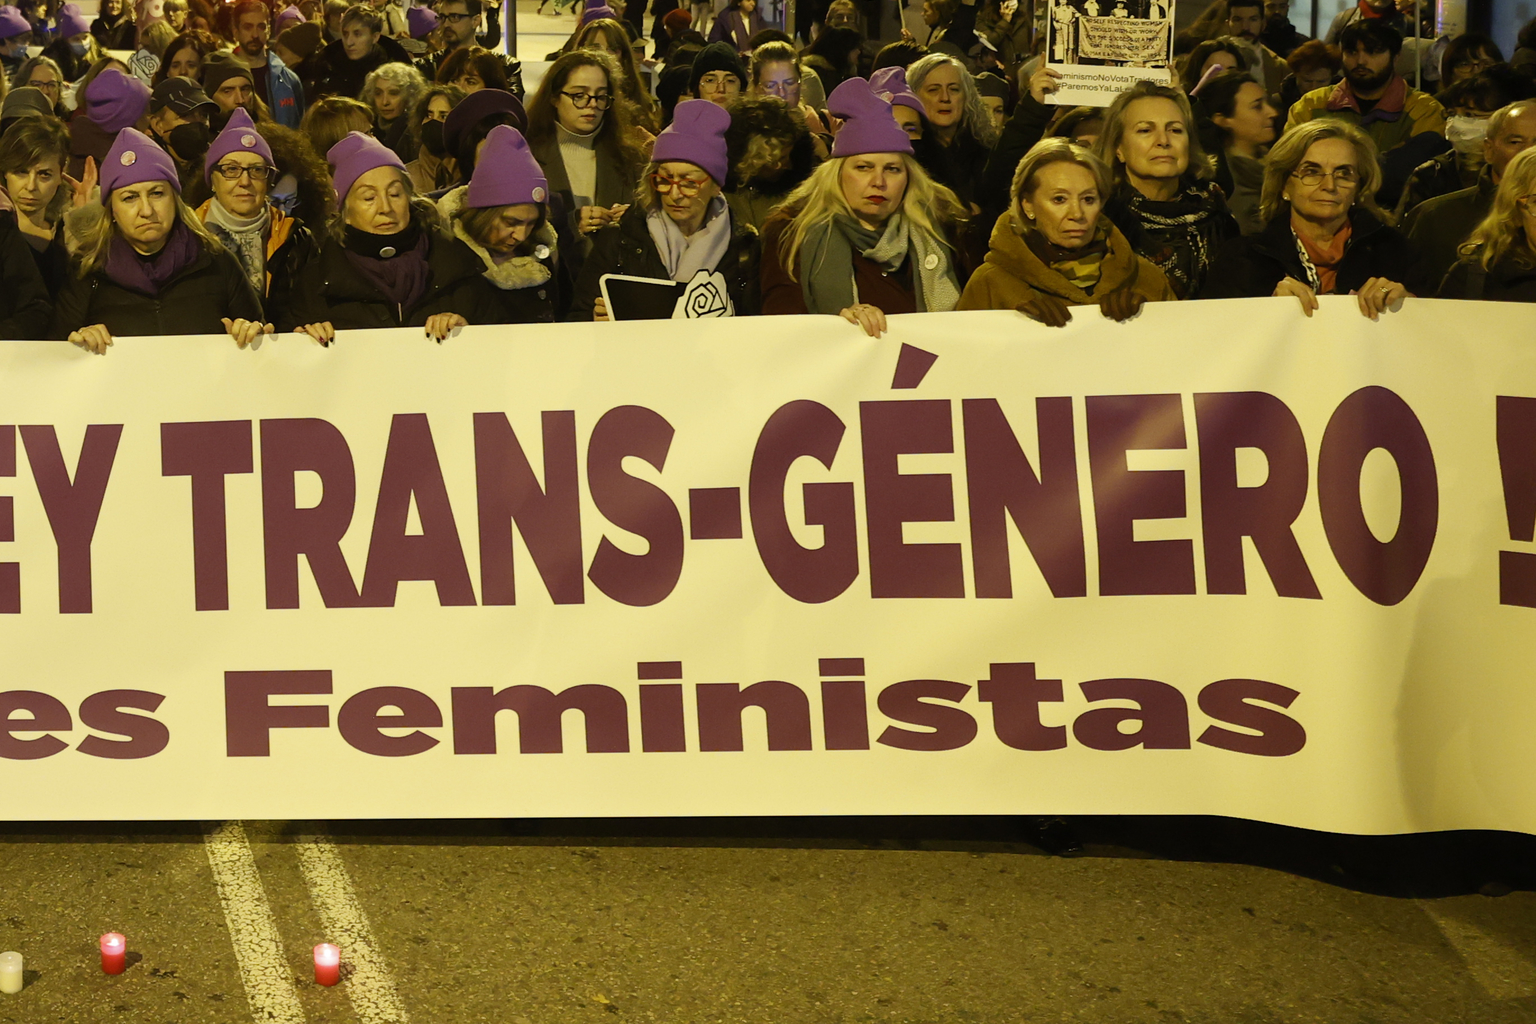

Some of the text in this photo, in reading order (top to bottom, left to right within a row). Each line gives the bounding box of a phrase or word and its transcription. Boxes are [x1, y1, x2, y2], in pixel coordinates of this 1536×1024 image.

[1059, 73, 1169, 84] eminismoNoVotaTraidores
[160, 342, 1439, 611] TRANS-GÉNERO
[224, 657, 1307, 757] Feministas
